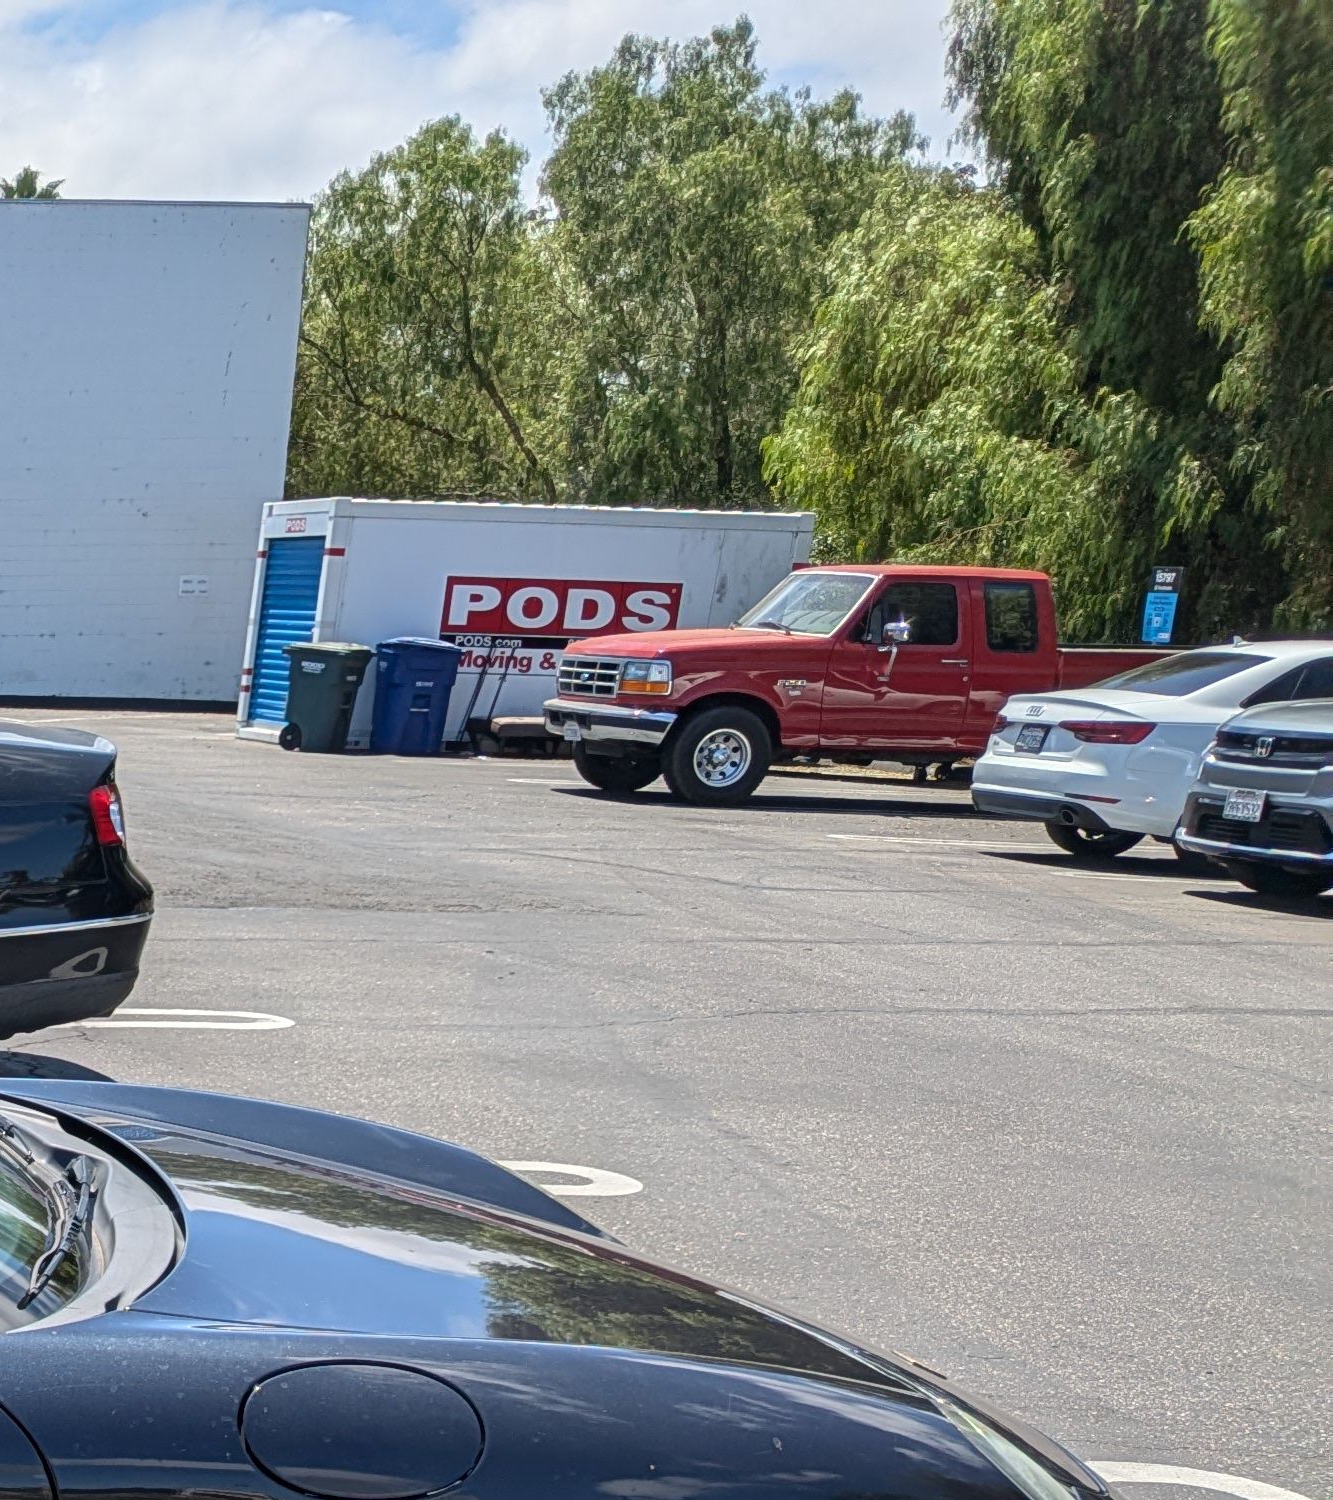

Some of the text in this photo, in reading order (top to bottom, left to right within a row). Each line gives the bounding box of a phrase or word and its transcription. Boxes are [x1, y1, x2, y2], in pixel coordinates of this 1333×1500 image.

[447, 584, 671, 632] PODS
[454, 635, 522, 648] PODS.com
[457, 650, 557, 673] Moving &
